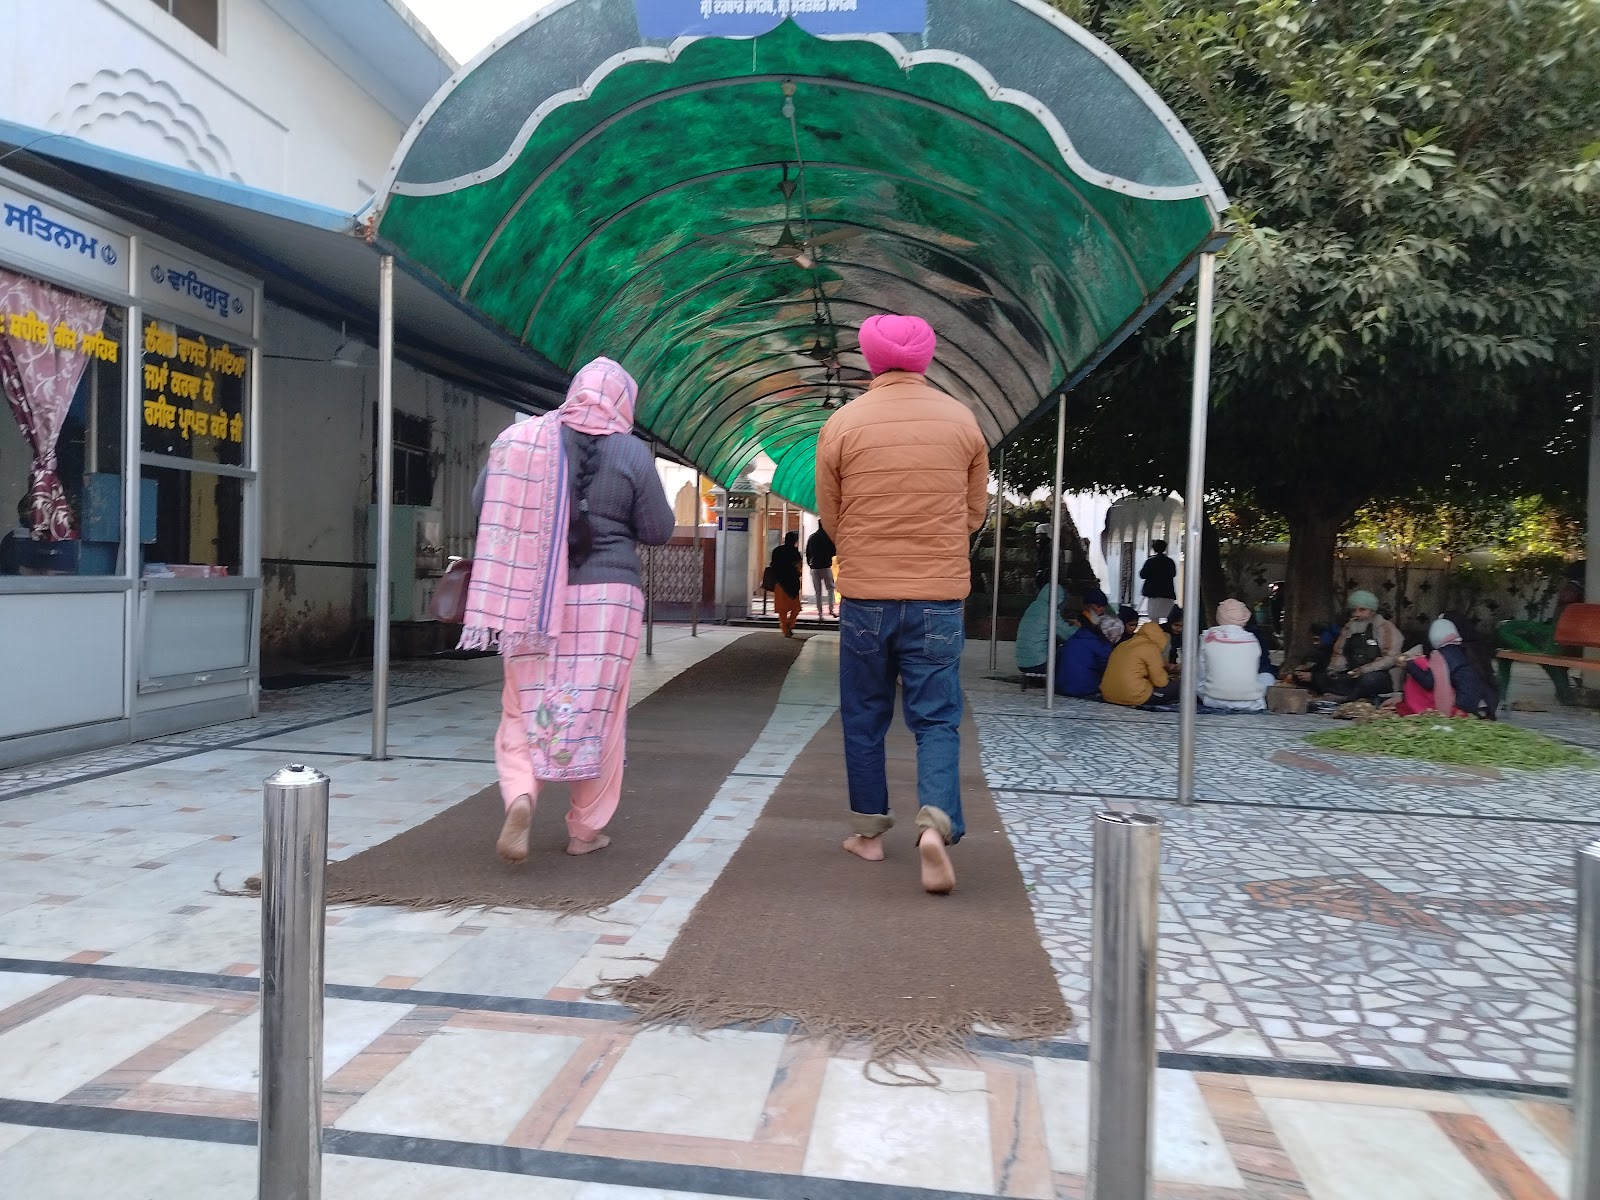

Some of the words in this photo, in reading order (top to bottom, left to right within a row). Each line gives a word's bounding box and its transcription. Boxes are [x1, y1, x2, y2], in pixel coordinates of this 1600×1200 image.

[4, 202, 98, 259] ਸਤਿਨਾਮ
[167, 268, 230, 318] ਵਾਹਿਗੁਰੂ
[81, 330, 118, 363] ਸਾਹਿਬ
[144, 320, 177, 358] ਲੰਗਰ
[178, 334, 208, 368] ਵਾਸਤੇ
[170, 370, 202, 401] ਕਰਵਾ
[203, 371, 214, 404] ਕੇ
[144, 394, 177, 429] ਰਸੀਦ
[178, 407, 209, 440] ਪ੍ਰਾਪਤ
[210, 407, 229, 440] ਕਰੋ
[229, 412, 243, 443] ਜੀ
